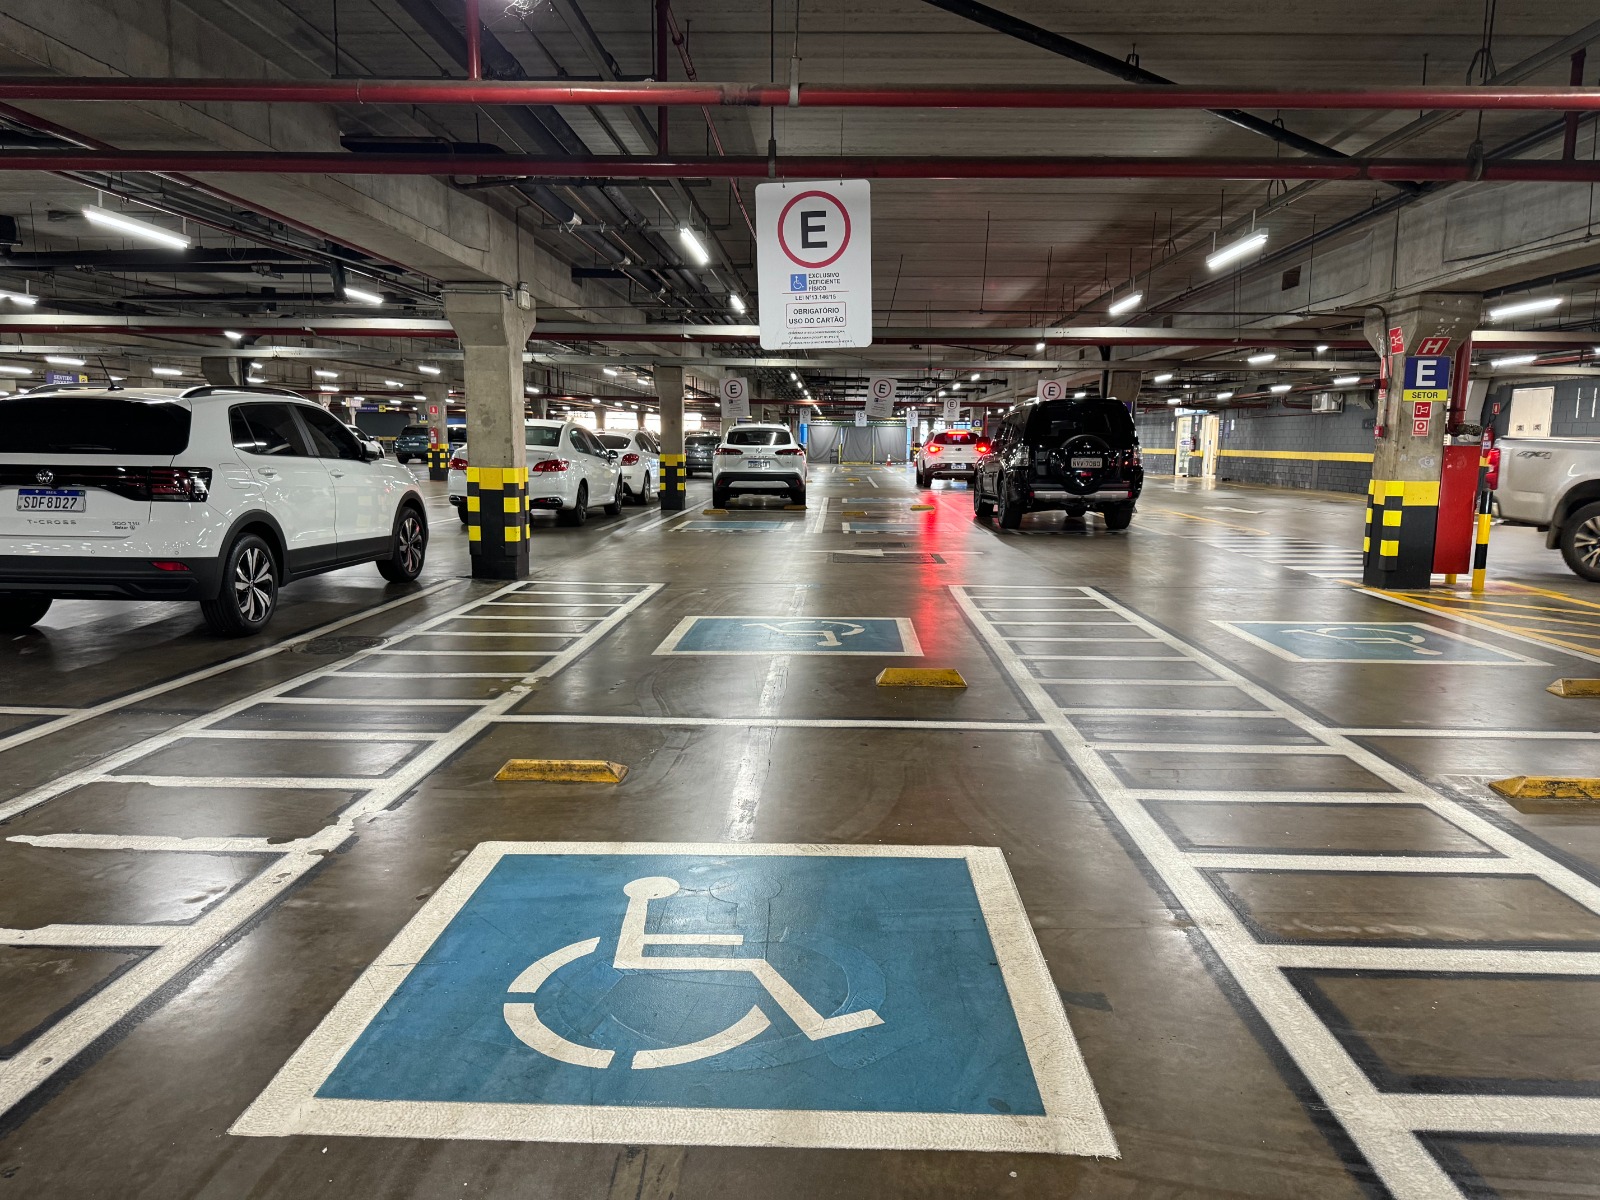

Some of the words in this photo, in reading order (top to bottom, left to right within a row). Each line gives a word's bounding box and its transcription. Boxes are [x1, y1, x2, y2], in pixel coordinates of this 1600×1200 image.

[800, 210, 828, 249] E
[1422, 340, 1444, 354] H
[1416, 360, 1438, 386] E
[730, 384, 738, 394] E
[878, 384, 887, 394] E
[1048, 386, 1056, 396] E
[24, 496, 78, 509] SDF8D27
